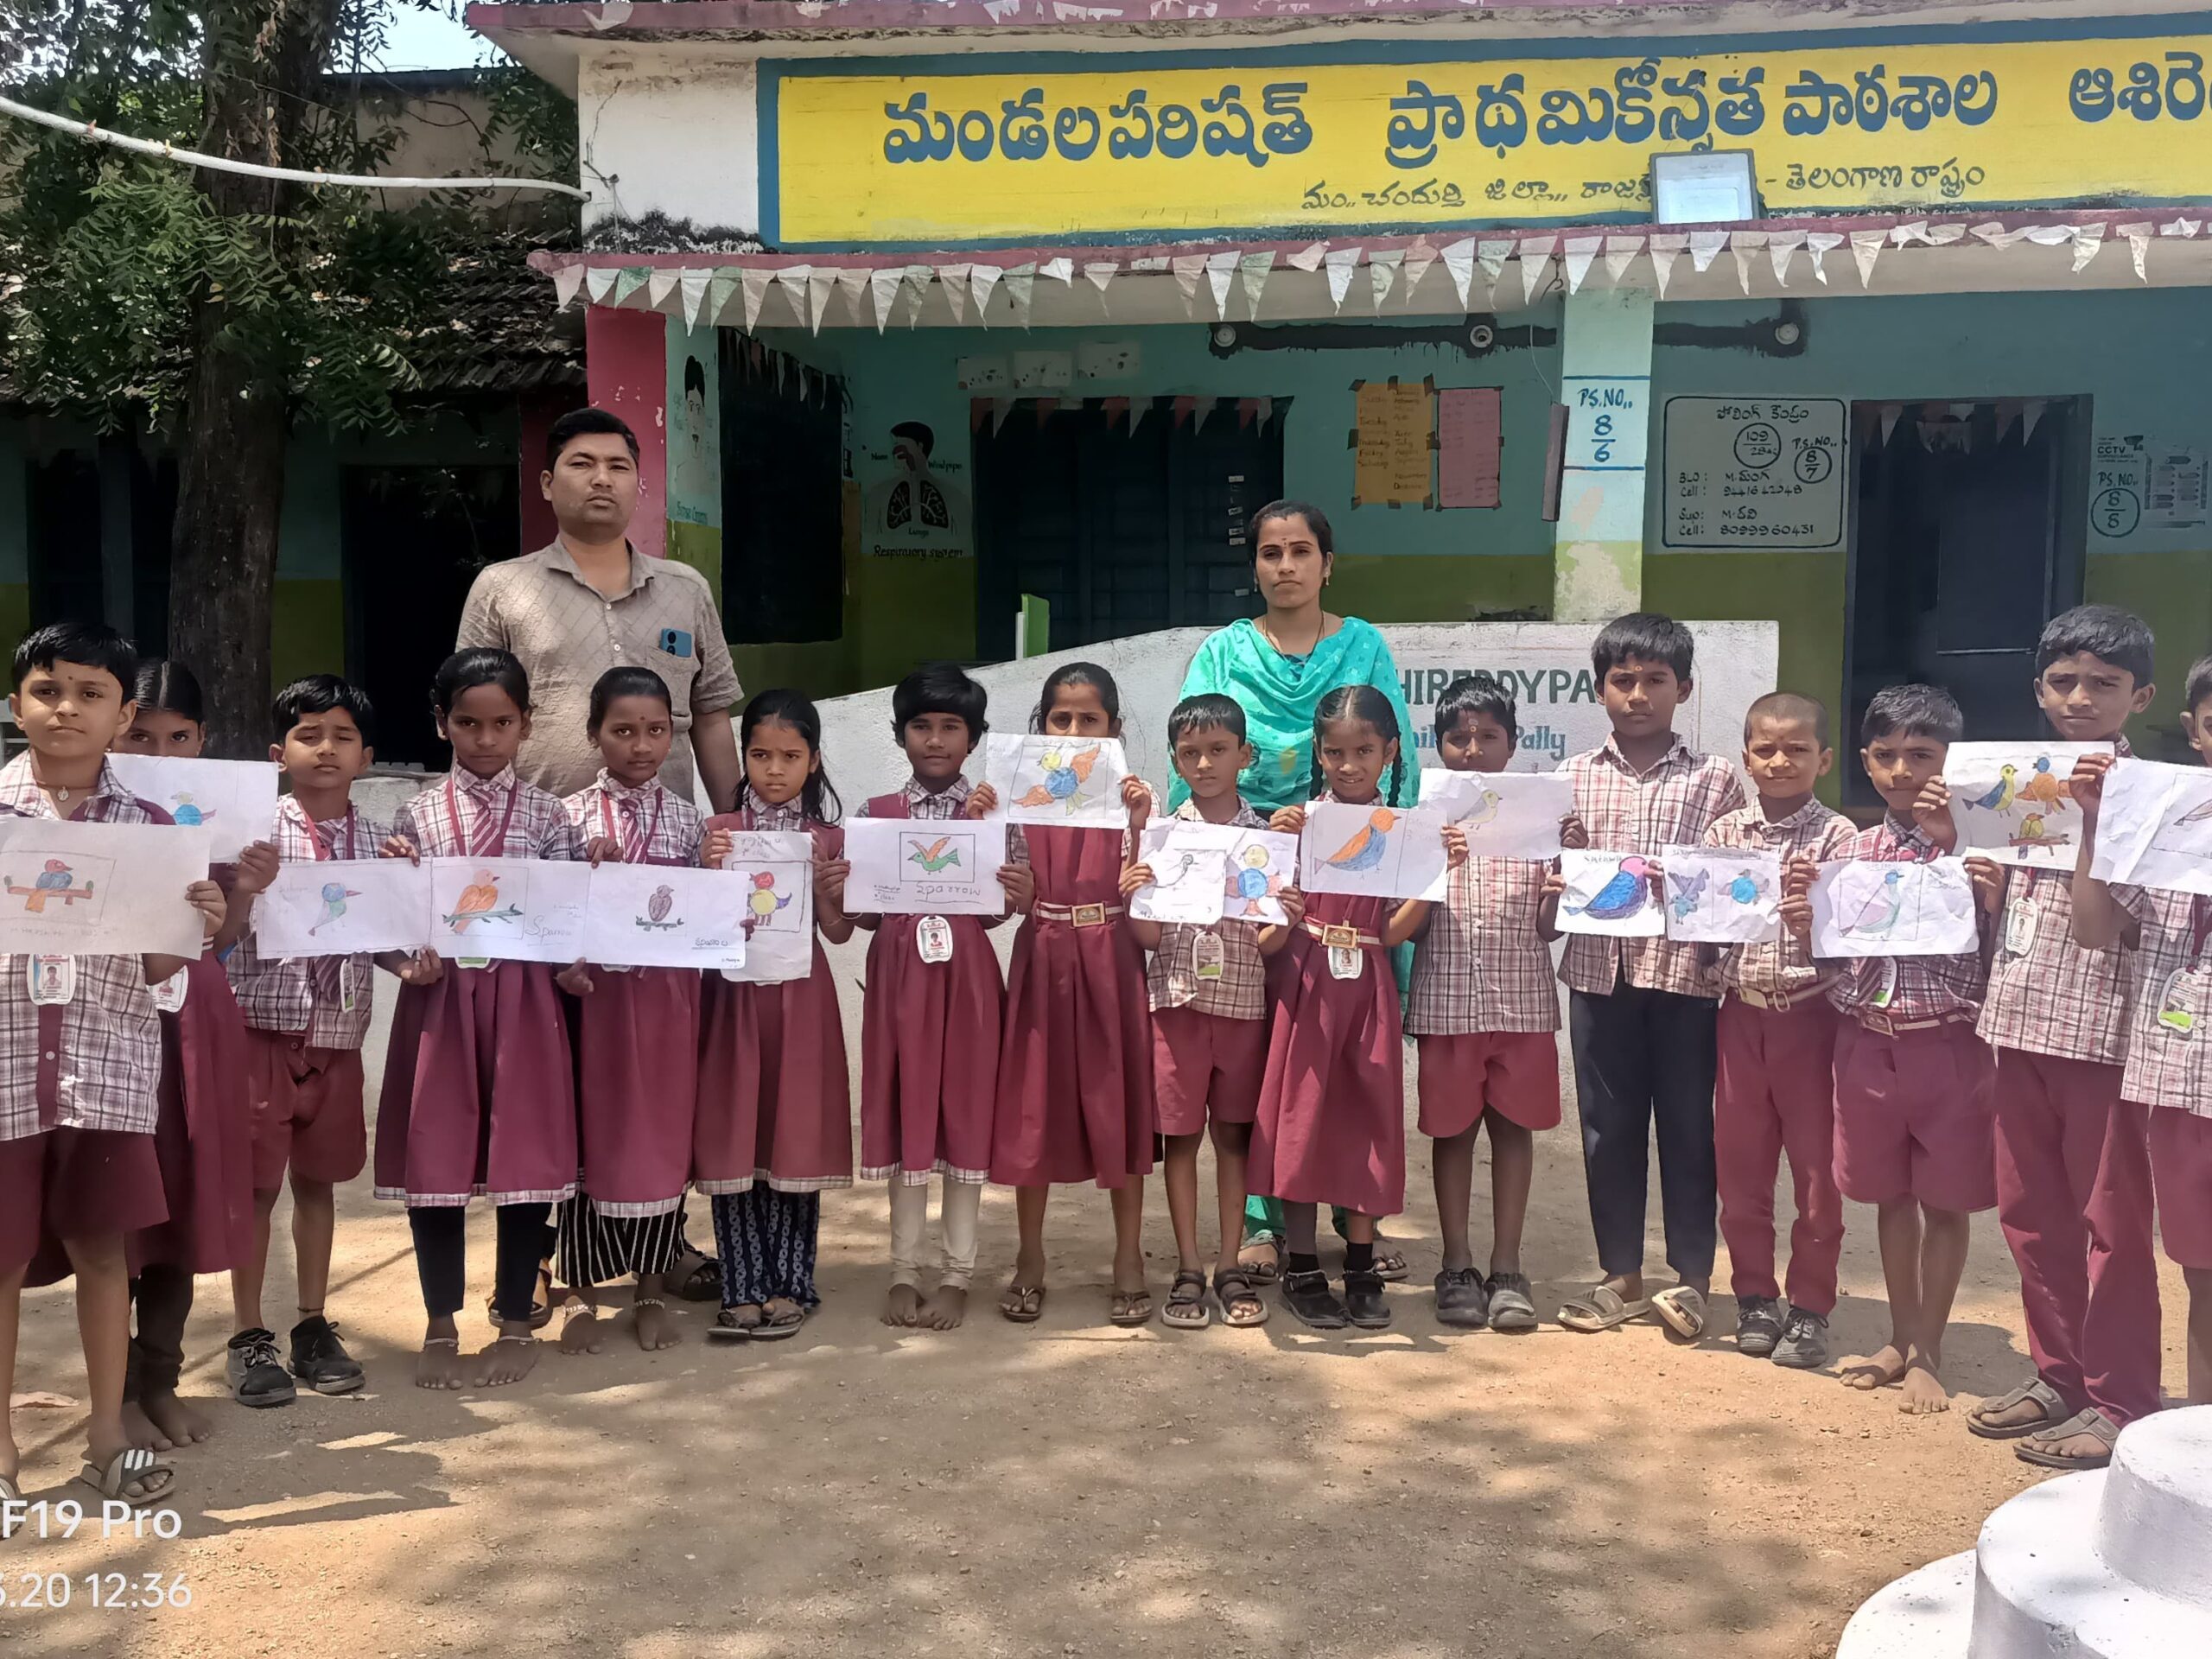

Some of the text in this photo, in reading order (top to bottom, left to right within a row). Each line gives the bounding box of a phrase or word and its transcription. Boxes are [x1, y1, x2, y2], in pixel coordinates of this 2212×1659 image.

[1783, 64, 1998, 136] పాఠశాల
[2069, 51, 2212, 123] ఆశిరె
[1786, 163, 1903, 189] తెలంగాణ
[1911, 157, 1986, 198] రాష్ట్రం
[1594, 415, 1612, 436] 8
[1746, 430, 1769, 442] 109
[1594, 443, 1610, 462] 6
[1806, 450, 1817, 462] 8
[1806, 467, 1818, 480] 7
